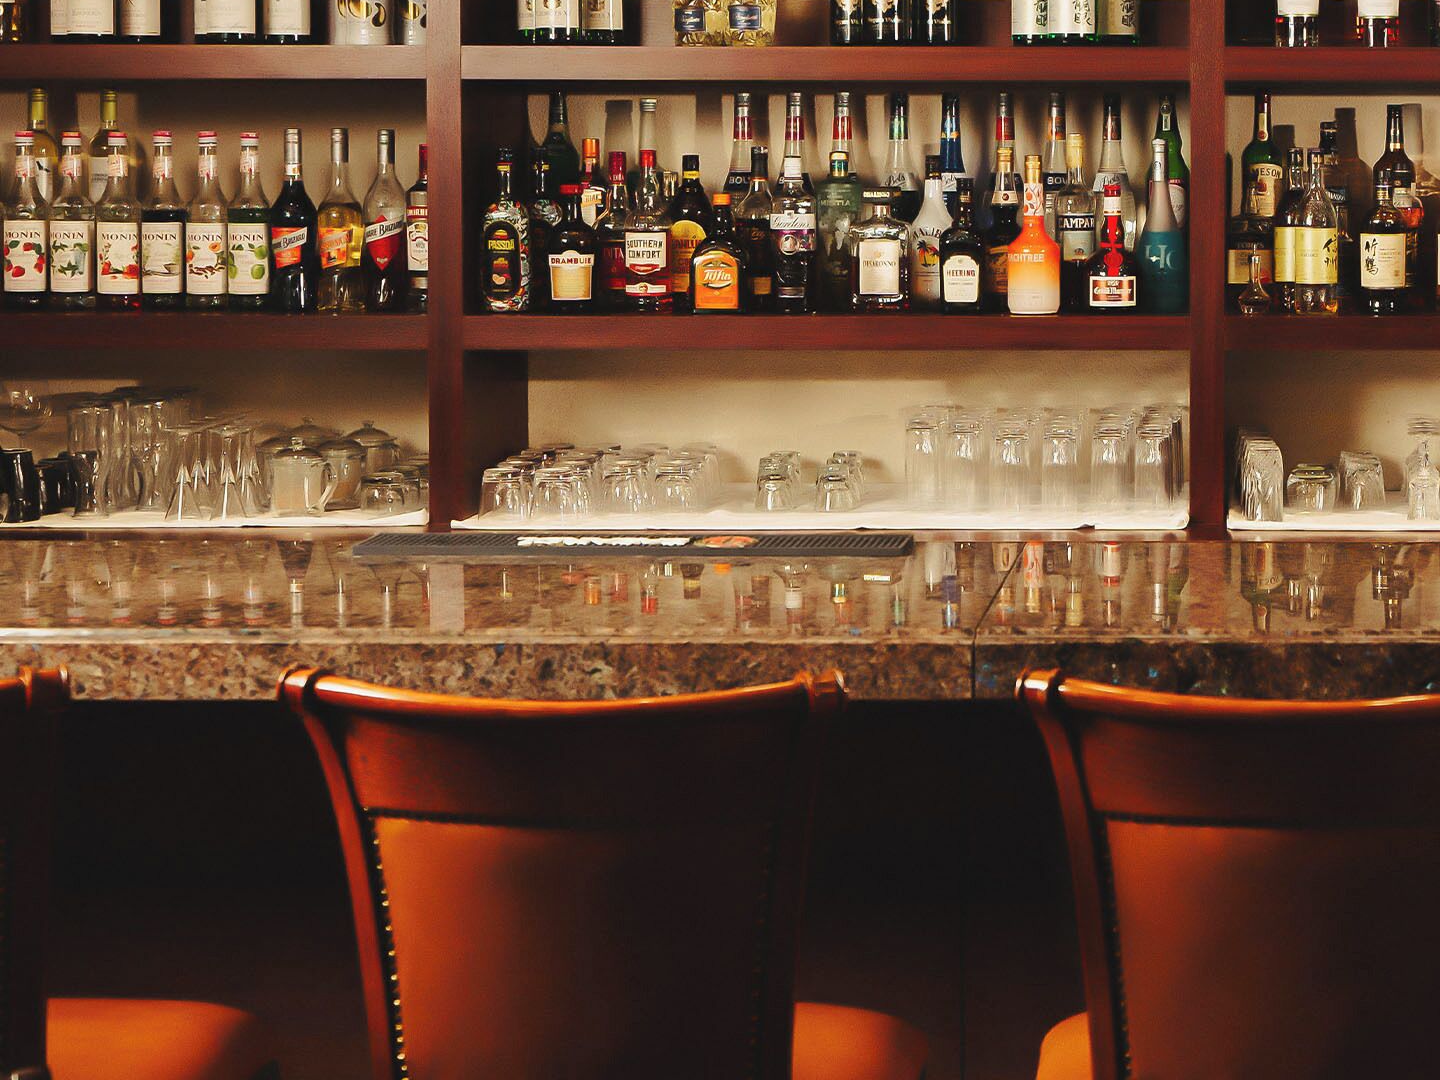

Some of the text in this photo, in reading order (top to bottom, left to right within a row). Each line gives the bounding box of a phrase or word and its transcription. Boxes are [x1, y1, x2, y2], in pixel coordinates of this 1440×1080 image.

[1257, 167, 1282, 180] ESON
[627, 239, 663, 249] SOUTHERN
[628, 250, 661, 259] COMFORT
[551, 257, 592, 265] DRAMBUIE
